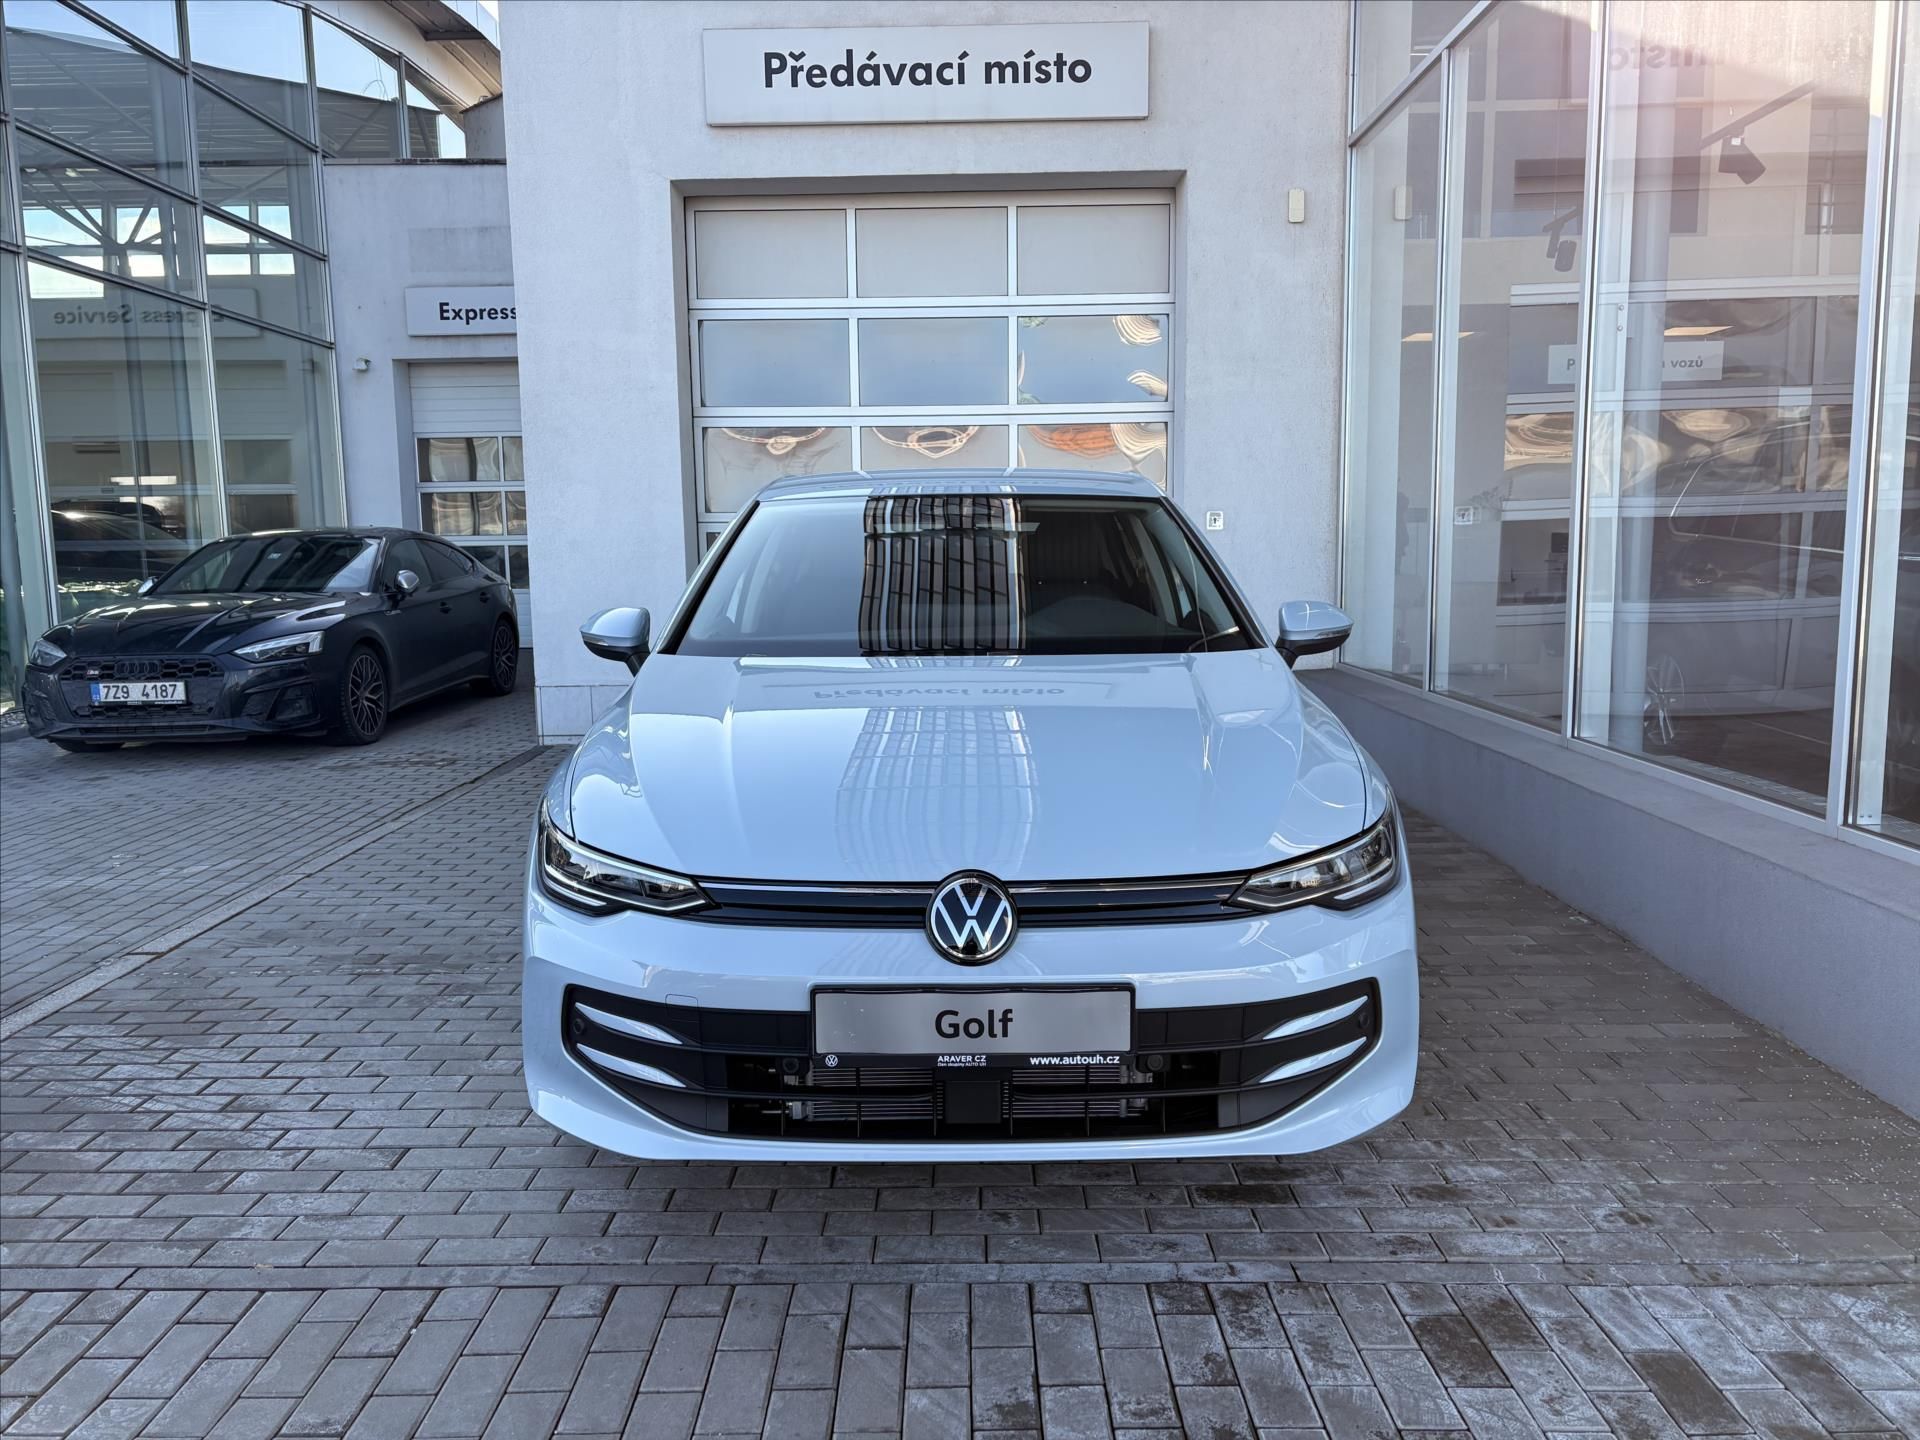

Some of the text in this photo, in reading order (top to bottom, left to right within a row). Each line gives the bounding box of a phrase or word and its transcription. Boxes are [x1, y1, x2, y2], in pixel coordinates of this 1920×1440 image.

[764, 49, 1092, 88] Předávací místo
[439, 302, 516, 325] Express
[1670, 356, 1704, 369] vozů
[103, 685, 130, 700] 7Z9
[142, 683, 177, 700] 4187
[935, 1008, 1013, 1039] Golf
[1030, 1054, 1120, 1065] www.autouh.cz
